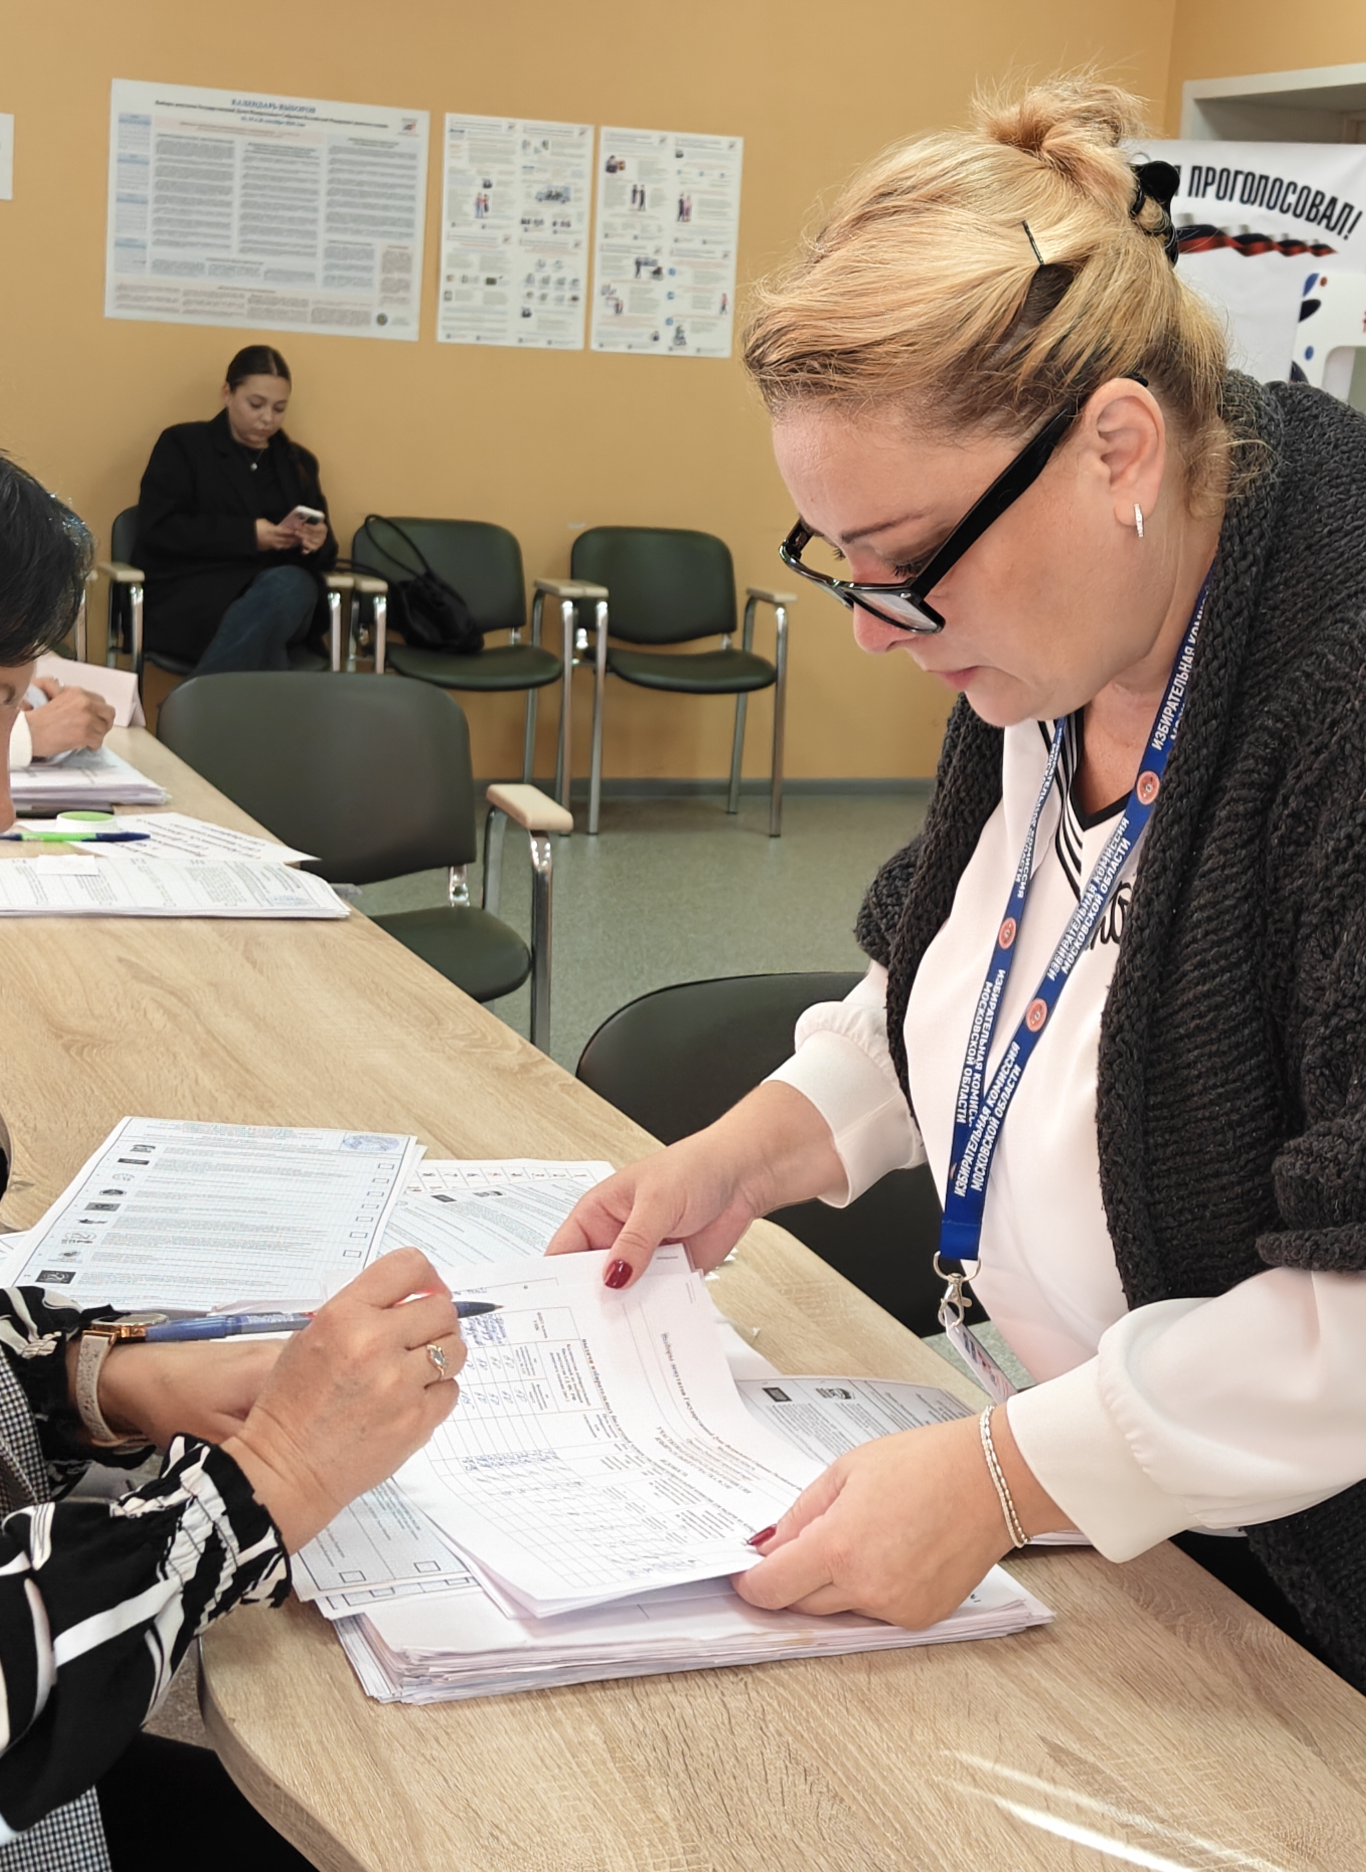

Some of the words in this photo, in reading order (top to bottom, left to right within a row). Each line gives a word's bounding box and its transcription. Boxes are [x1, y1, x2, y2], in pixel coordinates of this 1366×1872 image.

[1187, 165, 1363, 241] ПРОГОЛОСОВАЛ!
[1151, 645, 1195, 751] ИЗБИРАТЕЛЬНАЯ
[1046, 880, 1098, 982] ИЗБИРАТЕЛЬНАЯ
[1094, 817, 1130, 886] КОМИССИЯ
[1061, 893, 1105, 975] МОСКОВСКОЙ
[1100, 837, 1132, 896] ОБЛАСТИ
[966, 980, 992, 1066] МОСКОВСКОЙ
[975, 968, 1006, 1071] ИЗБИРАТЕЛЬНАЯ
[954, 1105, 992, 1198] ИЗБИРАТЕЛЬНАЯ
[985, 1041, 1021, 1110] КОМИССИЯ
[956, 1067, 973, 1124] ОБЛАСТИ
[971, 1116, 1001, 1192] МОСКОВСКОЙ
[994, 1064, 1023, 1117] ОБЛАСТИ
